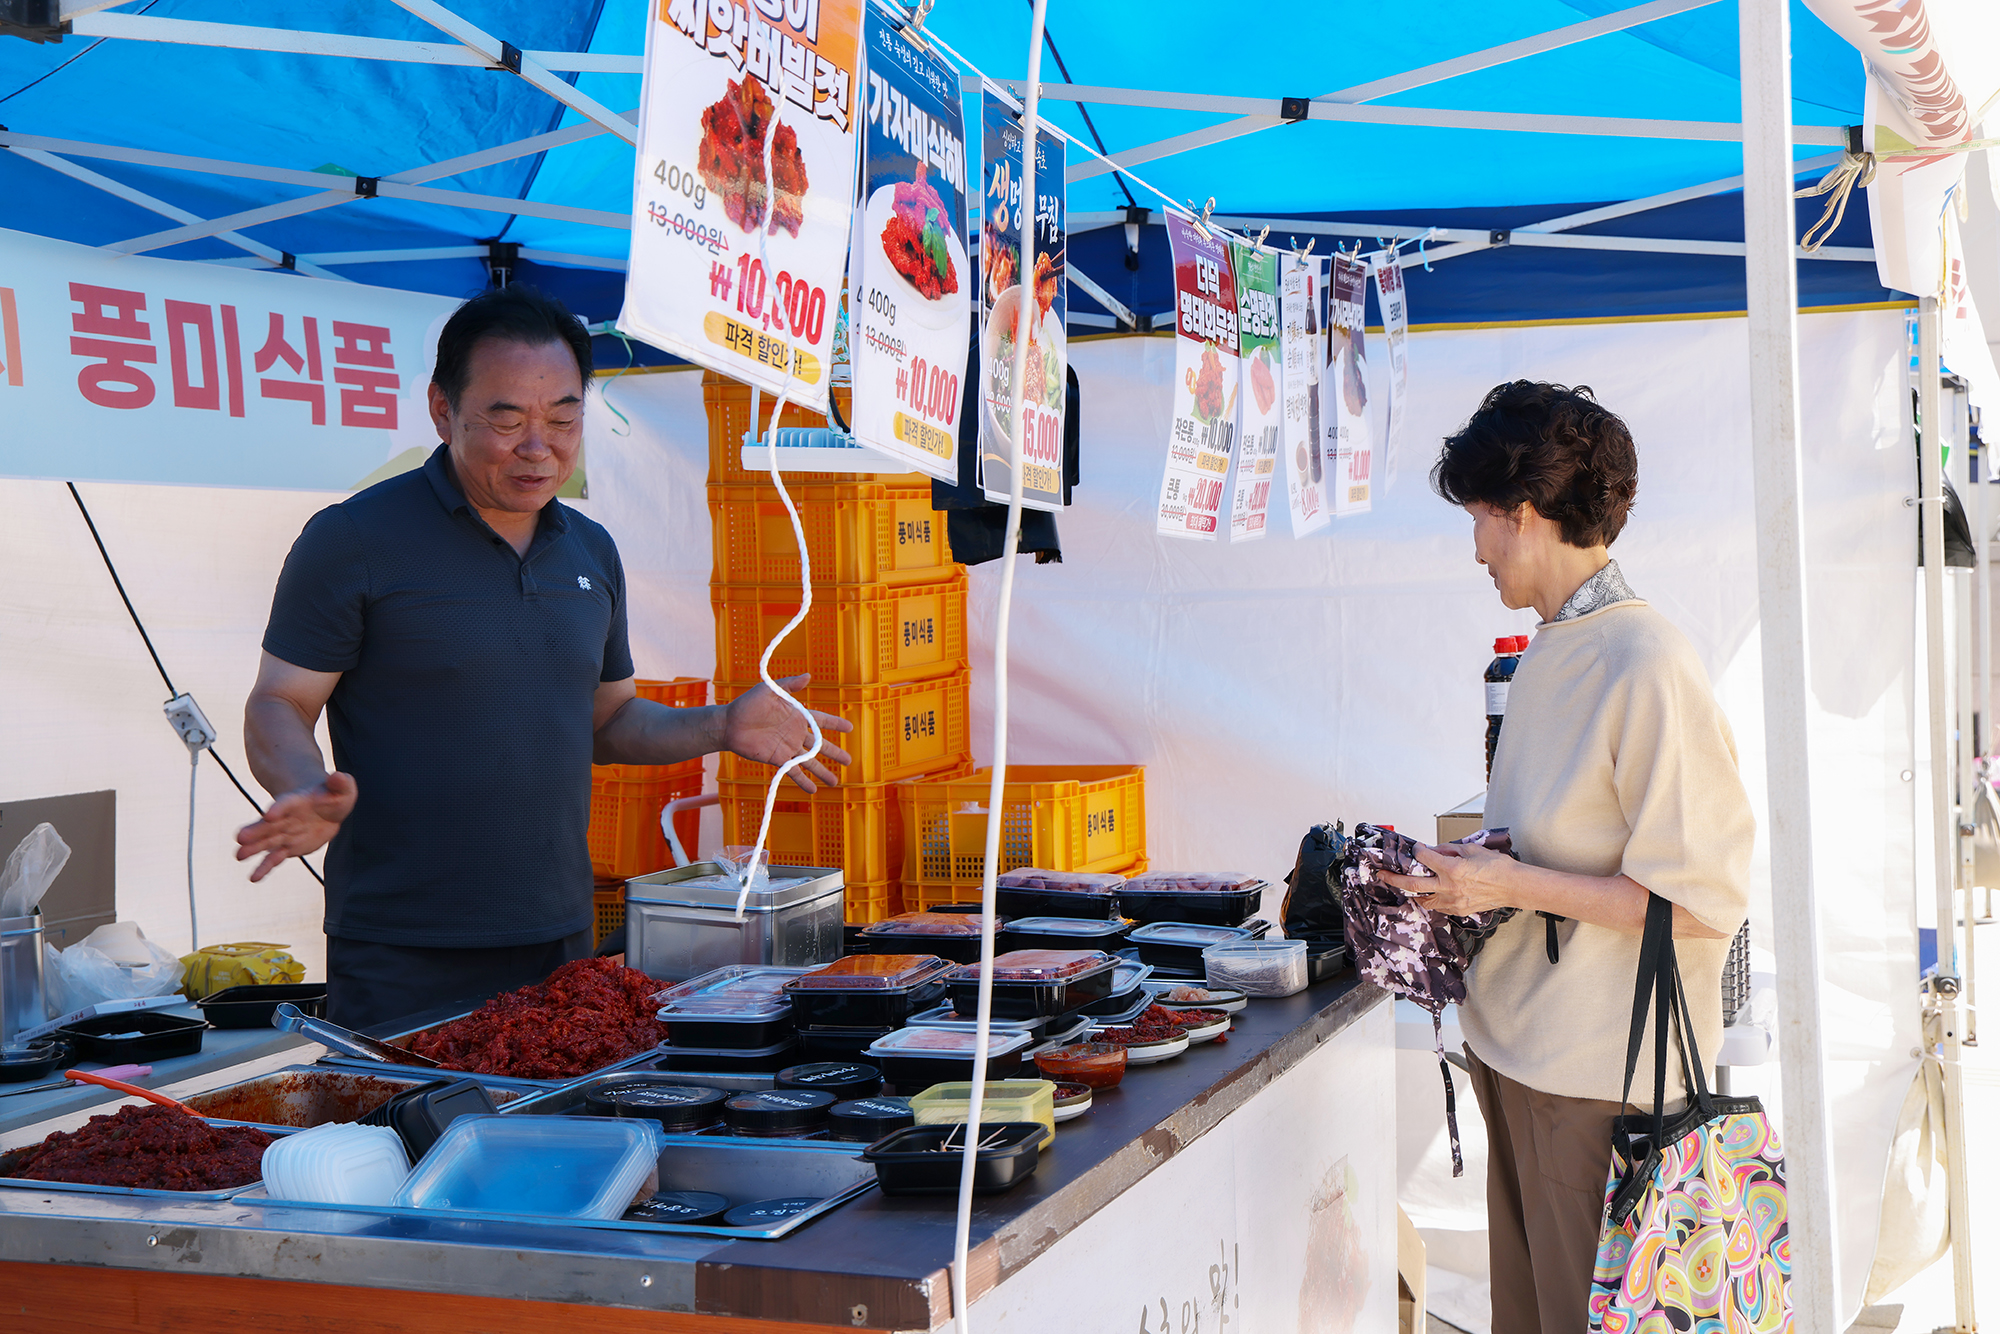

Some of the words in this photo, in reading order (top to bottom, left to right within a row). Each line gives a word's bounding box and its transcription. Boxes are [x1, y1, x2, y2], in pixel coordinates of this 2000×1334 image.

[868, 68, 964, 195] 가자미식해
[654, 159, 707, 210] 400g
[648, 202, 723, 256] 13,000원
[1196, 254, 1220, 301] 더덕
[868, 287, 896, 326] 400g
[1180, 290, 1238, 350] 명태회무침
[68, 280, 401, 430] 풍미식품
[725, 322, 753, 357] 파격
[865, 324, 905, 363] 13,000원
[987, 356, 1010, 387] 400g
[904, 418, 918, 443] 파격
[920, 424, 944, 455] 할인가!
[1175, 417, 1194, 444] 작은통
[1033, 466, 1052, 490] 할인가!
[897, 520, 932, 545] 풍미식품
[903, 617, 935, 648] 풍미식품
[904, 709, 936, 742] 풍미식품
[1087, 807, 1116, 839] 풍미식품
